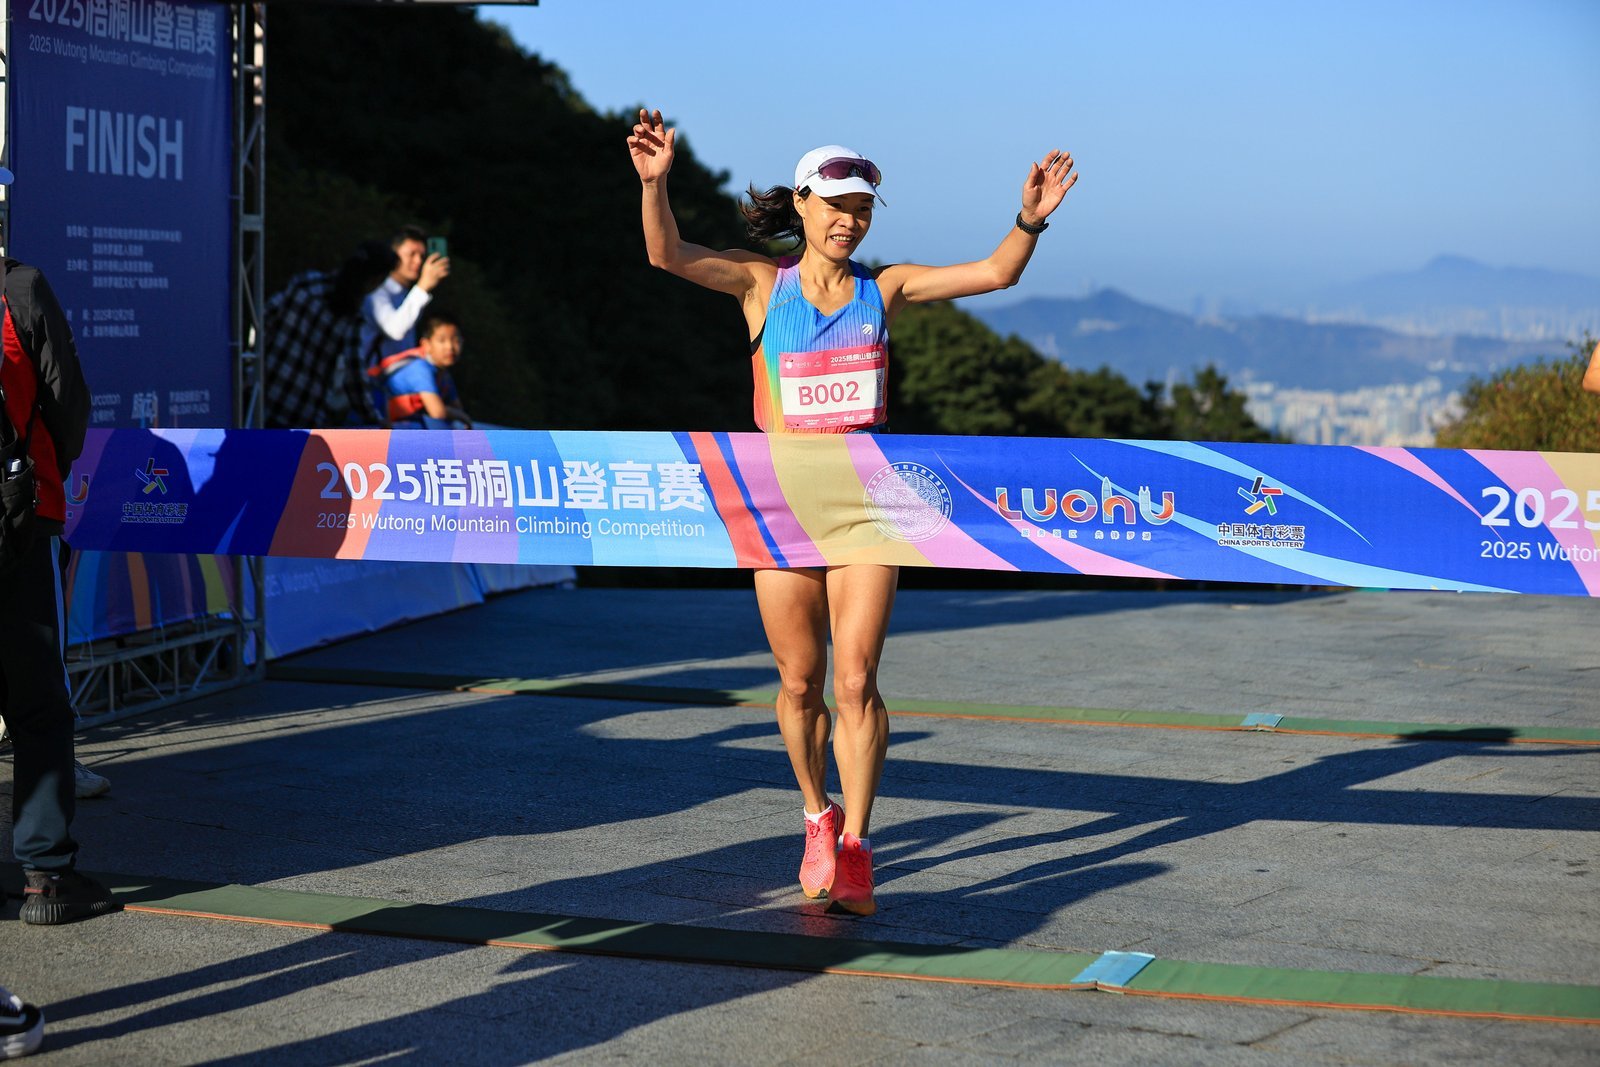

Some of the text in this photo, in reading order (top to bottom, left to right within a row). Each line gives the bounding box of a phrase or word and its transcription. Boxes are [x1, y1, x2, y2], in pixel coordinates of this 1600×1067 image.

[29, 34, 51, 54] 2025
[53, 38, 88, 63] Wutong
[89, 44, 129, 66] Mountain
[66, 105, 184, 181] FINISH
[798, 381, 860, 406] B002
[316, 458, 705, 513] 2025梧桐山登高赛
[122, 501, 189, 516] 中国体育彩票
[316, 512, 705, 540] 2025 Wutong Mountain Climbing Competition
[1218, 523, 1304, 539] 中国体育彩票
[1480, 540, 1532, 560] 2025
